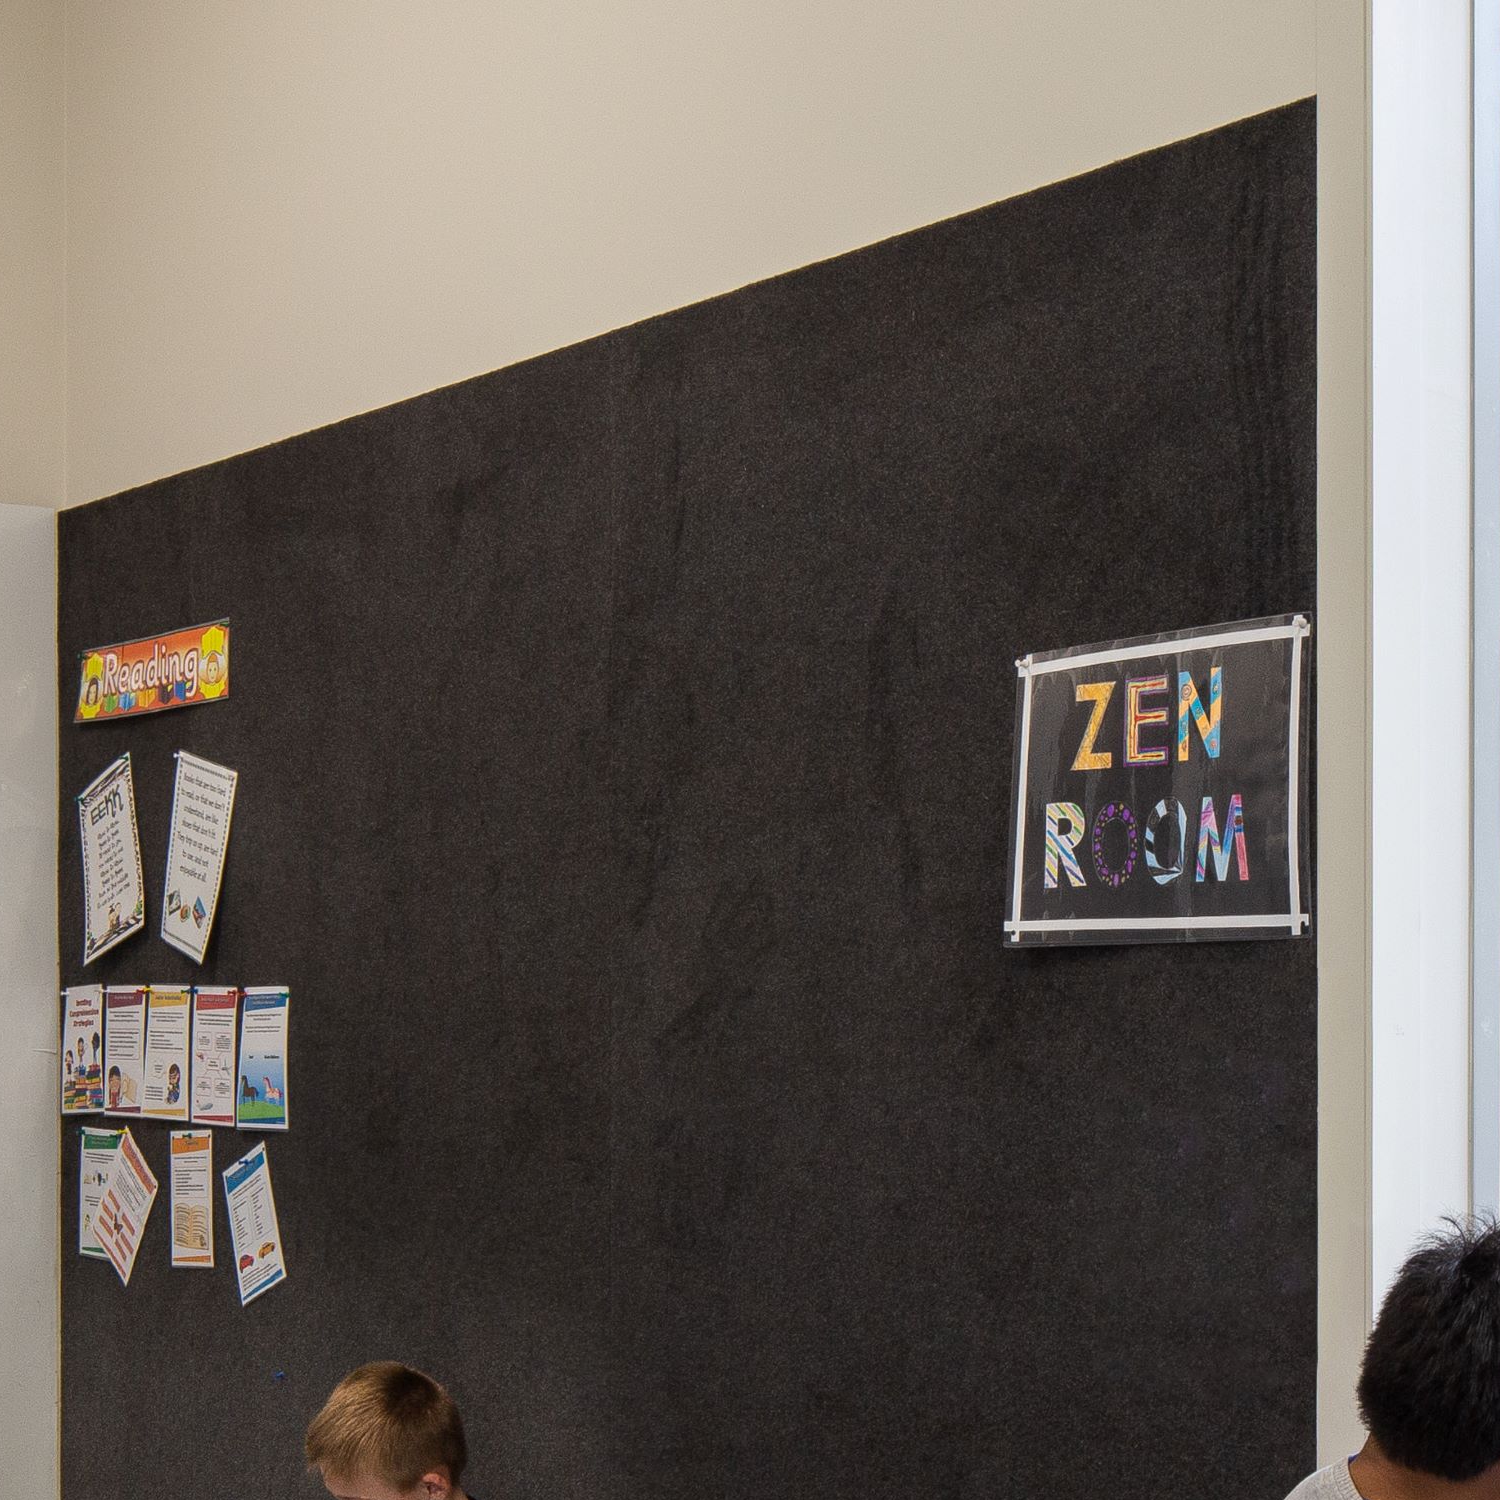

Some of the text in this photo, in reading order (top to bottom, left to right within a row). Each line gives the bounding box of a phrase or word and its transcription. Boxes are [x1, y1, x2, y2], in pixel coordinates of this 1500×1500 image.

[102, 643, 199, 697] Reading
[1070, 666, 1222, 771] ZEN
[90, 784, 124, 826] EEKK
[1044, 794, 1249, 888] ROOM
